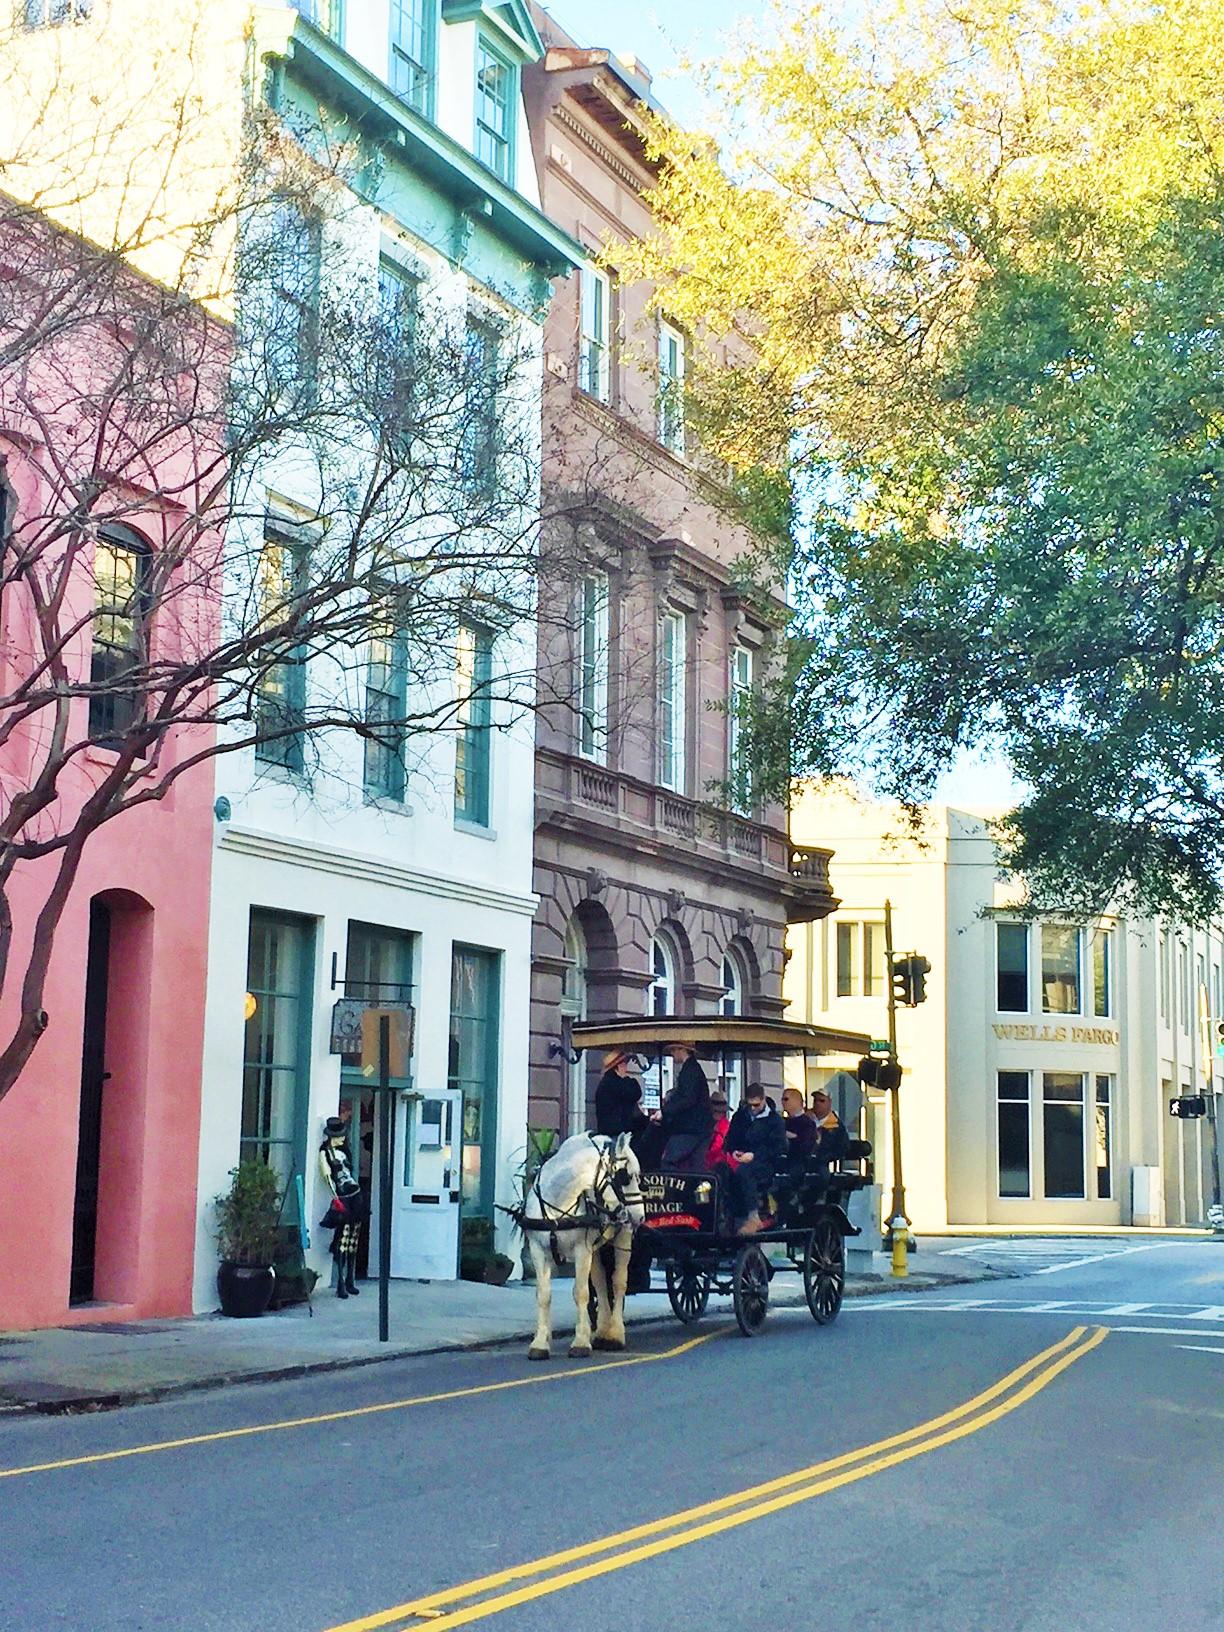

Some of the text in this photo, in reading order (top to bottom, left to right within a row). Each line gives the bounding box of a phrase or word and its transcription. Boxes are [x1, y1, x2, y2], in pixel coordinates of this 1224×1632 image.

[991, 1023, 1120, 1046] WELLS FARGO
[643, 1175, 686, 1191] SOUTH
[645, 1202, 684, 1213] RIAGE
